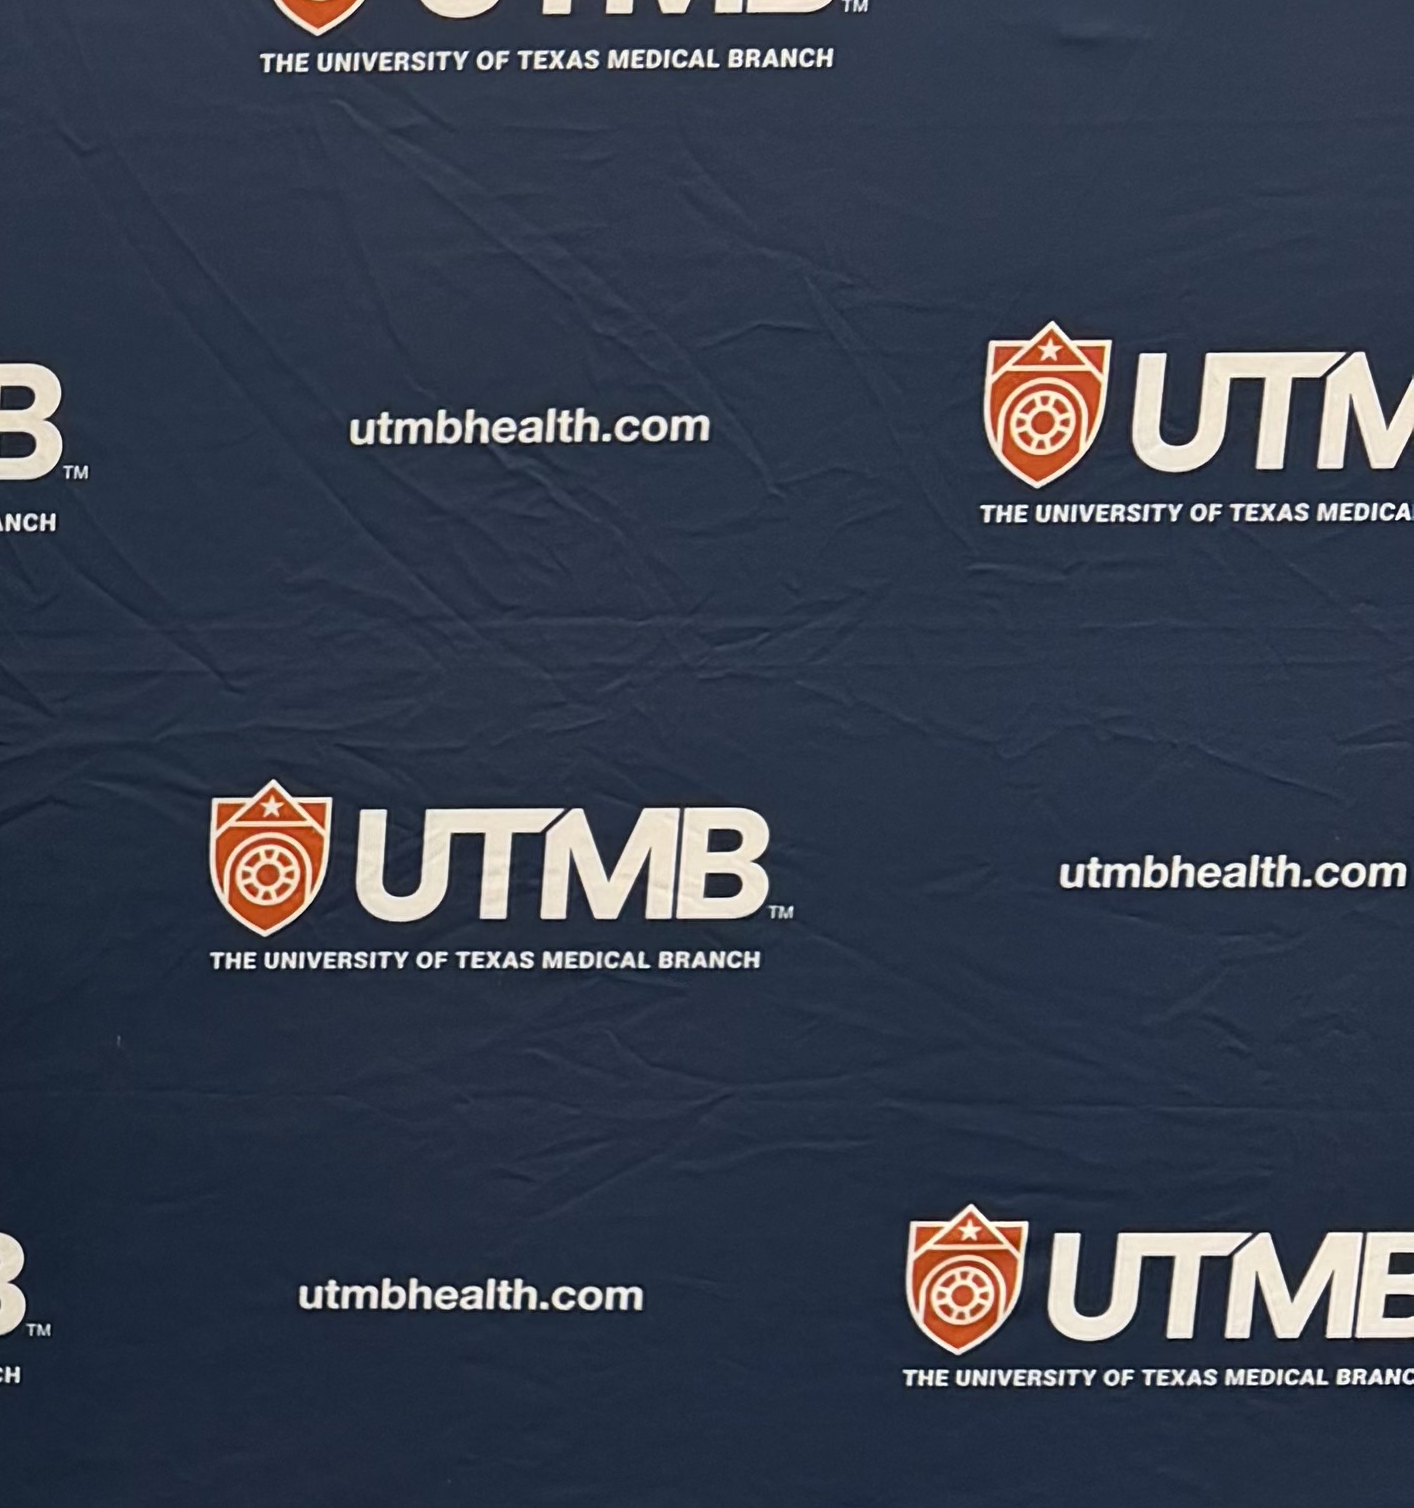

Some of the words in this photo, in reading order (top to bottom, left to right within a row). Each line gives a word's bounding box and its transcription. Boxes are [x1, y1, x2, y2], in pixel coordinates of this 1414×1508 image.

[259, 52, 310, 73] THE
[316, 50, 470, 73] UNIVERSITY
[476, 50, 511, 71] OF
[516, 49, 600, 70] TEXAS
[607, 48, 721, 70] MEDICAL
[727, 47, 834, 69] BRANCH
[349, 407, 711, 446] utmbhealth.com
[1132, 351, 1414, 473] UTM
[356, 807, 769, 922] UTMB
[1059, 854, 1407, 889] utmbhealth.com
[209, 951, 258, 970] THE
[264, 951, 409, 970] UNIVERSITY
[415, 950, 449, 969] OF
[454, 950, 535, 969] TEXAS
[541, 950, 651, 969] MEDICAL
[658, 950, 761, 969] BRANCH
[299, 1277, 644, 1311] utmbhealth.com
